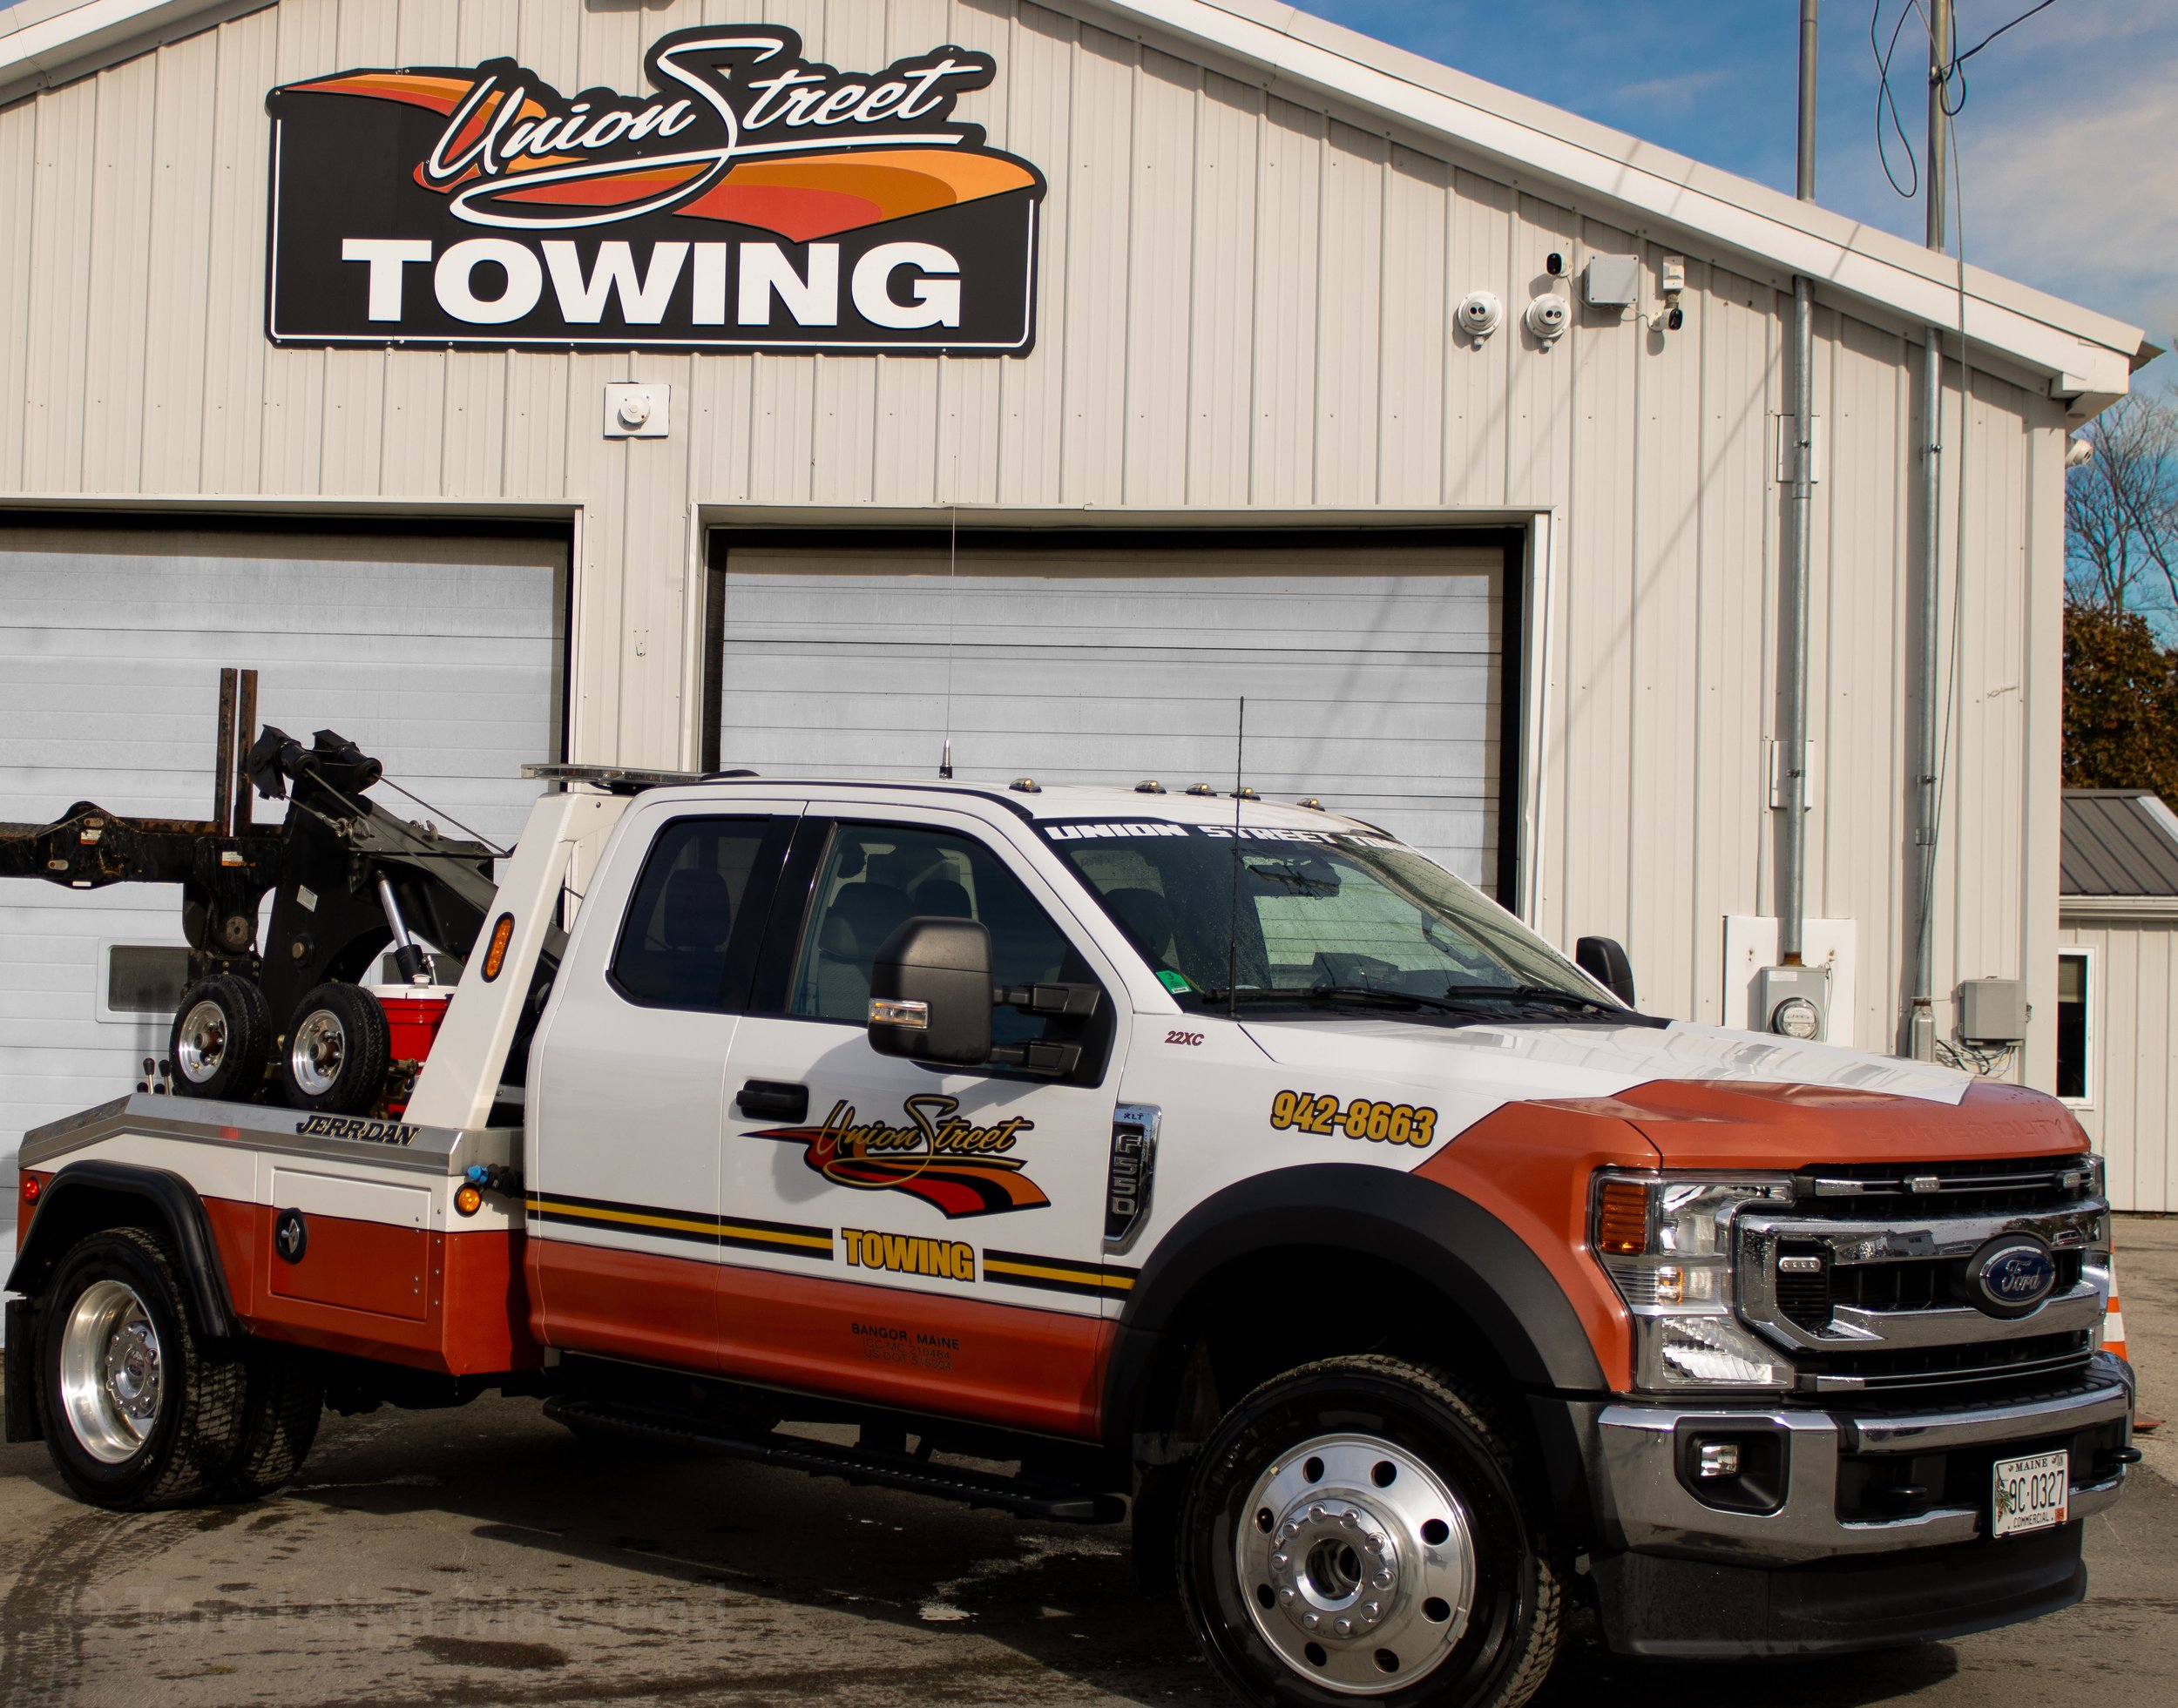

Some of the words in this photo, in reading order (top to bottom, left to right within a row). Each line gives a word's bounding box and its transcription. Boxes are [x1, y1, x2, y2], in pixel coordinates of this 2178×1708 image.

[427, 74, 696, 179] Union
[342, 237, 962, 328] TOWING
[1045, 823, 1190, 840] UNION
[1198, 825, 1338, 845] STREET
[1164, 1030, 1205, 1046] 22XC
[815, 1099, 922, 1156] Union
[1123, 1112, 1144, 1121] XLT
[1269, 1089, 1438, 1149] 942-8663
[841, 1226, 977, 1283] TOWING
[2001, 1259, 2040, 1293] Ford
[851, 1322, 912, 1344] BANGOR,
[917, 1333, 960, 1351] MAINE
[2015, 1457, 2048, 1473] MAINE
[2013, 1511, 2050, 1529] COMMERCIAL
